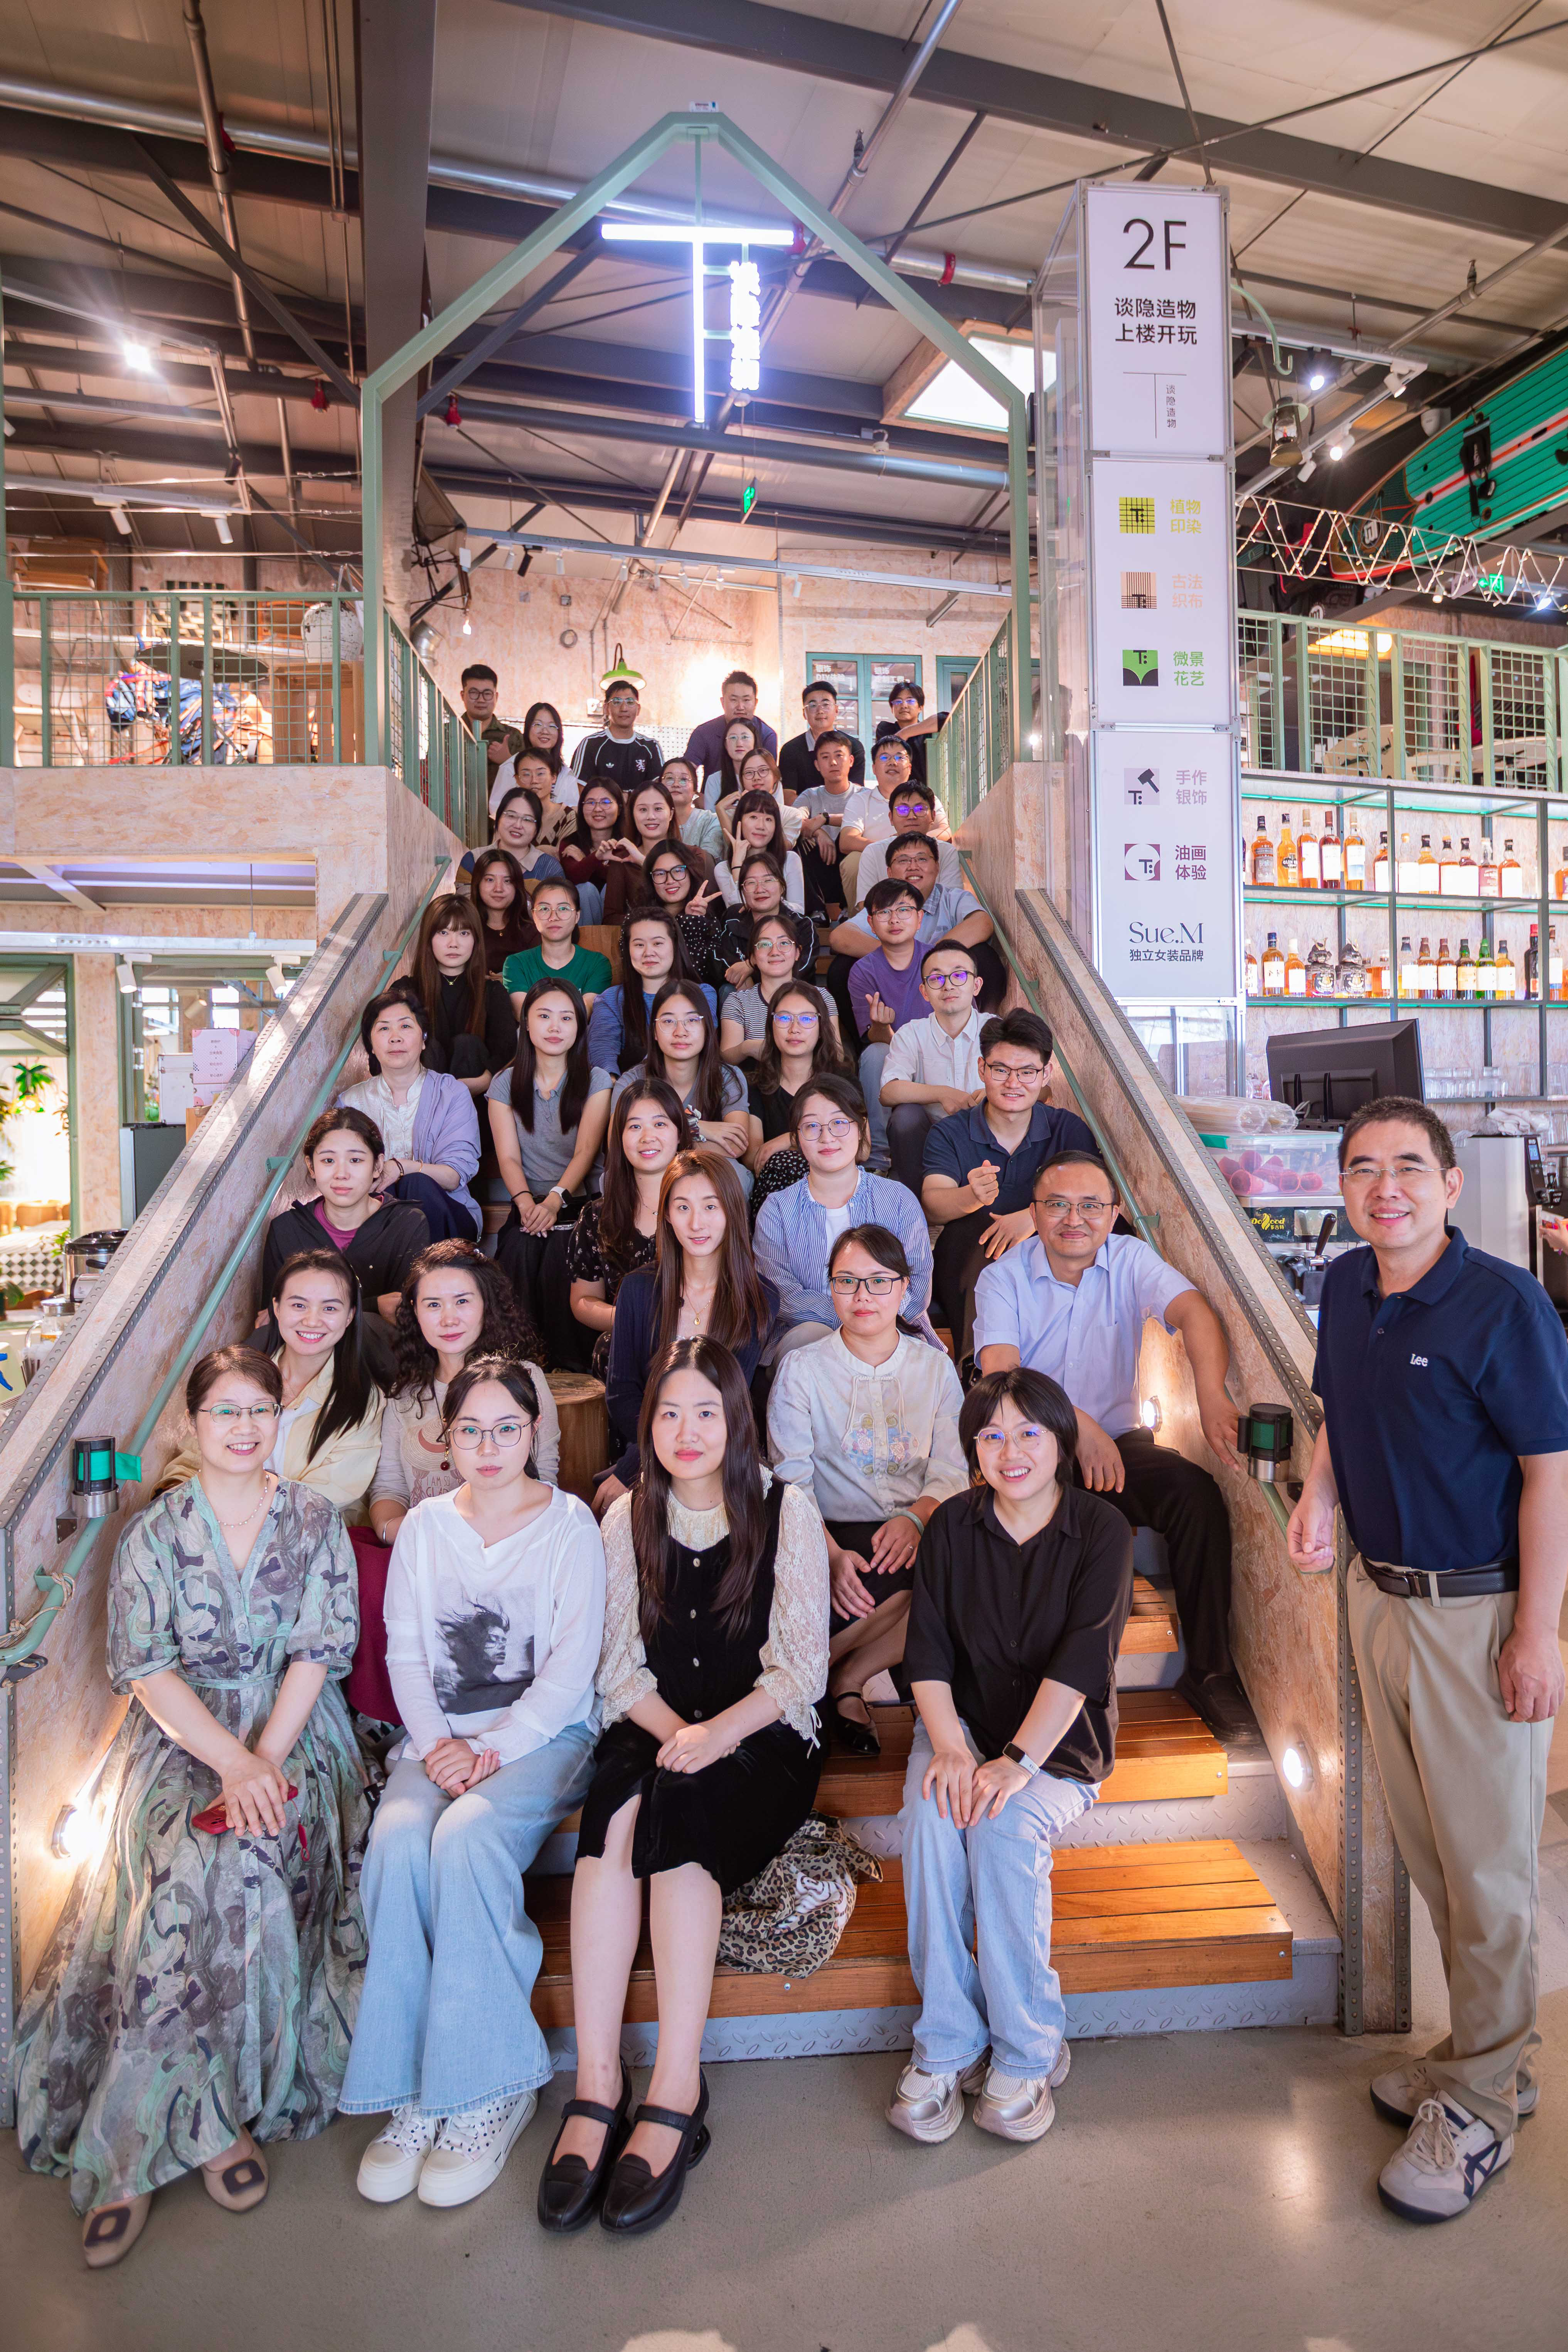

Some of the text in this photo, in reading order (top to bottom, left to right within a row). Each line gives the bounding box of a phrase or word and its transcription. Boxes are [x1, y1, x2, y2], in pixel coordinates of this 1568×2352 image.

[1123, 218, 1186, 270] 2F
[1115, 297, 1196, 319] 谈隐造物
[1115, 323, 1197, 345] 上楼开玩
[1165, 384, 1176, 428] 谈隐造物
[1170, 499, 1201, 514] 植物
[1170, 519, 1202, 534] 印染
[1172, 574, 1203, 589] 古法
[1172, 593, 1203, 608] 织布
[1173, 651, 1204, 667] 微景
[1174, 670, 1205, 686] 花艺
[1176, 769, 1207, 786] 手作
[1176, 789, 1207, 805] 银饰
[1175, 845, 1206, 861] 油画
[1175, 864, 1206, 881] 体验
[1129, 922, 1203, 943] Sue.M
[1130, 949, 1204, 962] 独立女装品牌
[1410, 1354, 1428, 1367] Lee
[426, 1476, 450, 1487] I AM SO
